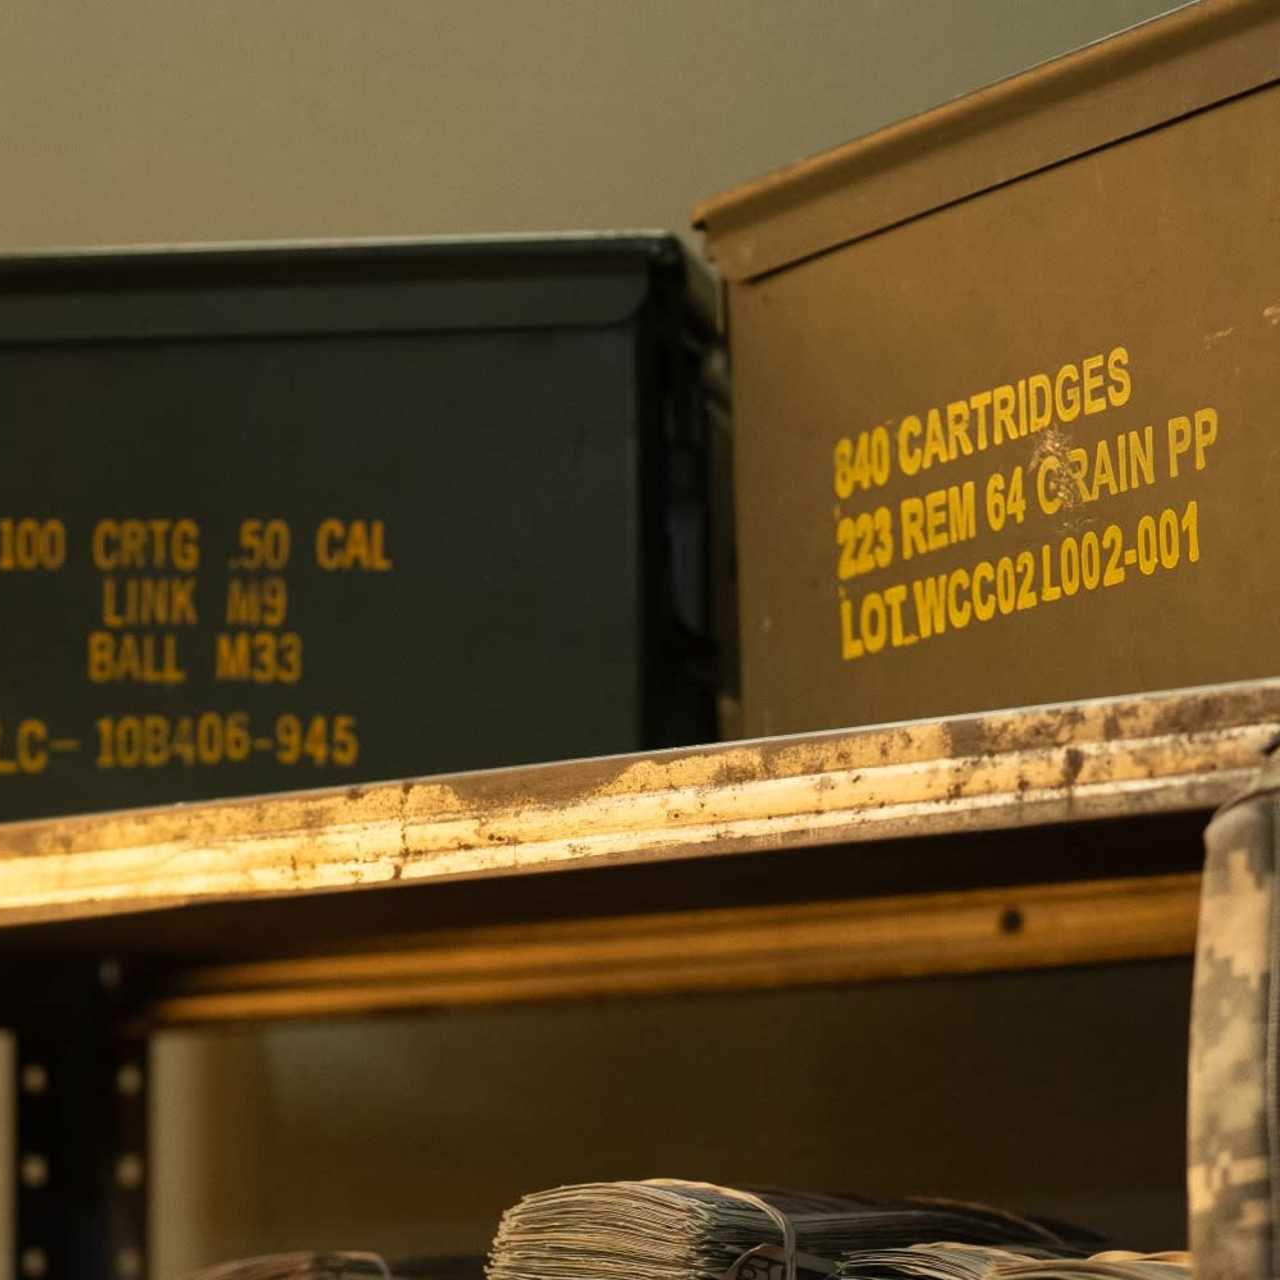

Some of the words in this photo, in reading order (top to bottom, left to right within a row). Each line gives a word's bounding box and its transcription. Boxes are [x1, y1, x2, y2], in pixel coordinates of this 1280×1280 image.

[897, 346, 1132, 476] CARTRIDGES
[836, 506, 894, 581] 223
[900, 481, 977, 560] REM
[986, 466, 1027, 532] 64
[1167, 407, 1219, 478] PP
[92, 518, 200, 571] CRTG
[315, 518, 392, 572] CAL
[102, 577, 198, 627] LINK
[226, 577, 288, 627] M9
[87, 631, 187, 683] BALL
[216, 631, 302, 683] M33
